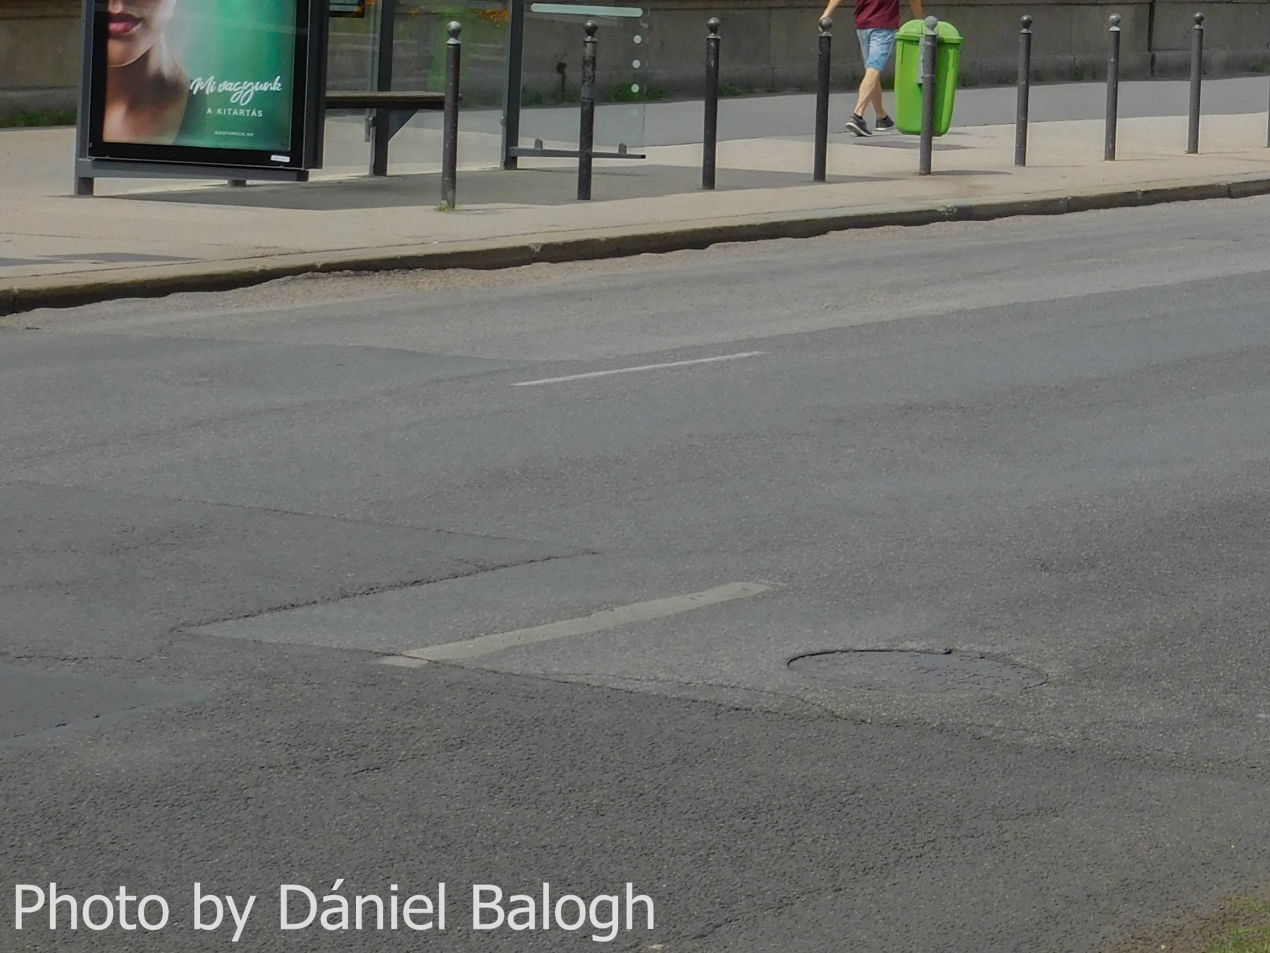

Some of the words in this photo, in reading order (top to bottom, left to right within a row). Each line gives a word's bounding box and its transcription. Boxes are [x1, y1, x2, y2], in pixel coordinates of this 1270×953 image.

[189, 75, 217, 95] Mi
[217, 75, 282, 106] vagyunk
[206, 107, 213, 115] A
[217, 108, 263, 118] KITARTÁS
